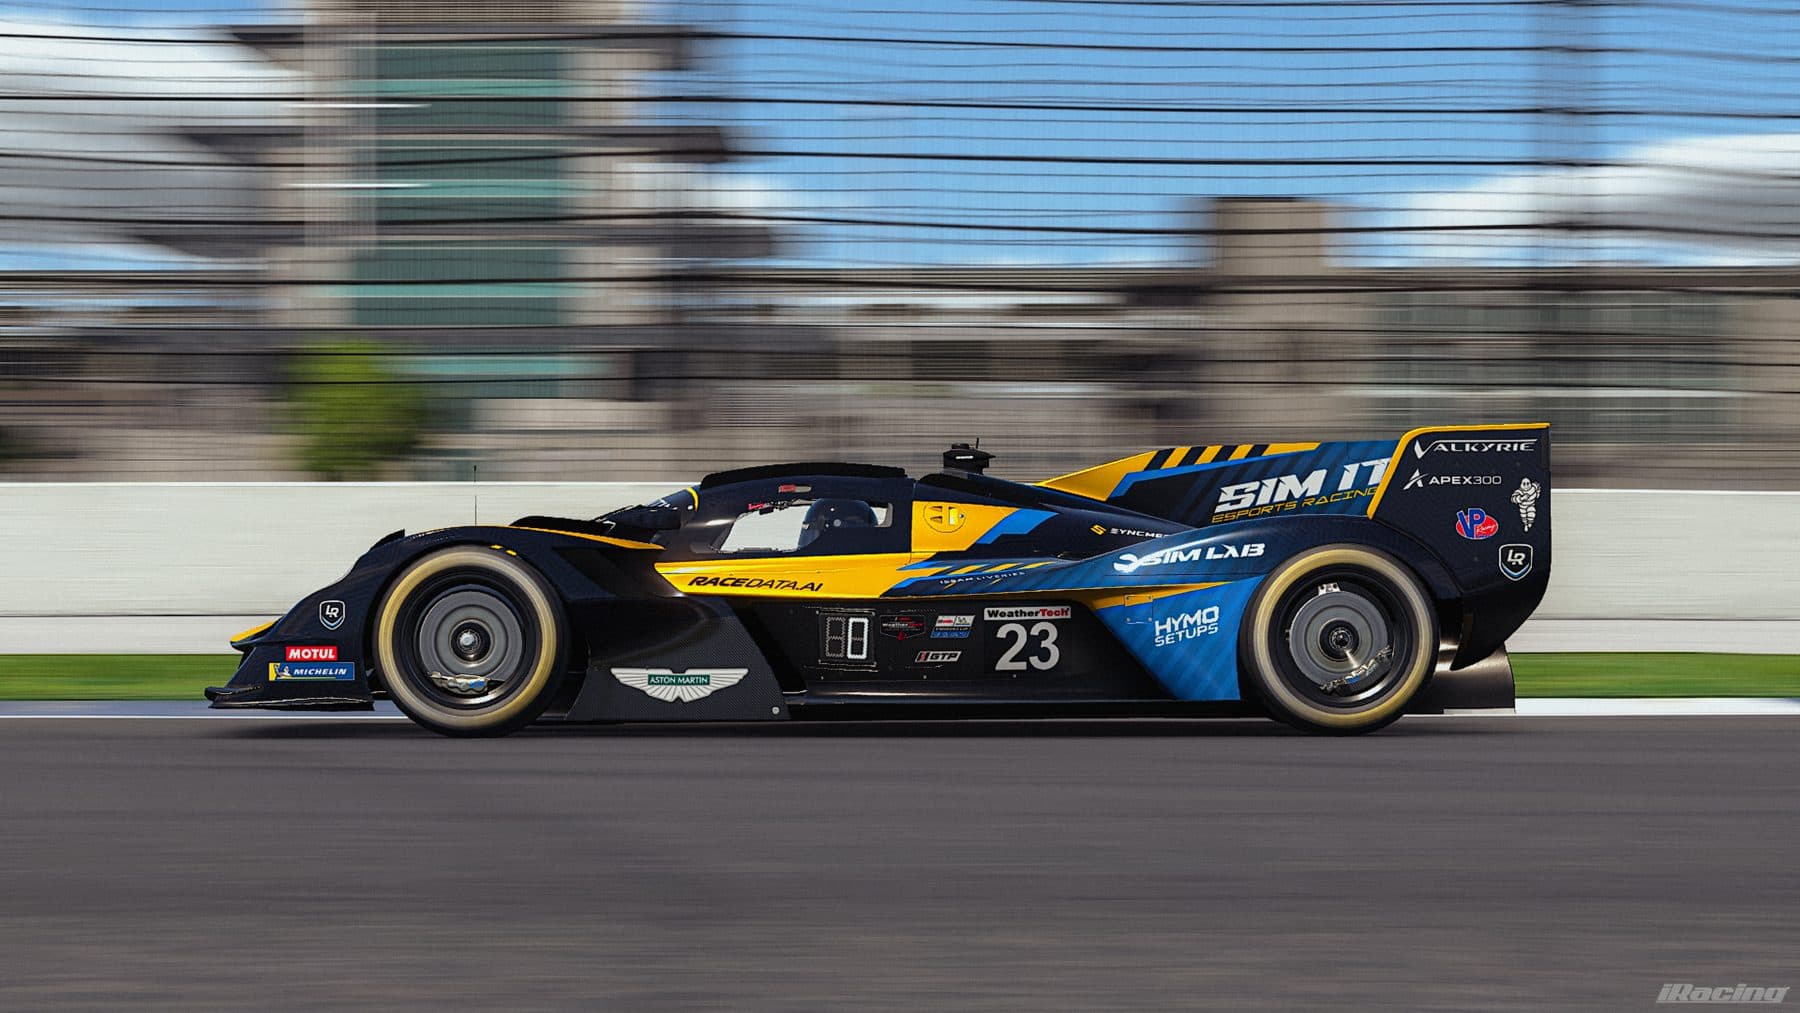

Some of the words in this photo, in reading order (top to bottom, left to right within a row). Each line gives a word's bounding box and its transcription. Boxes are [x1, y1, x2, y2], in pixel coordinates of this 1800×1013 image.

[1415, 438, 1537, 459] VALKYRIE
[1213, 469, 1327, 514] SIM
[1338, 457, 1391, 491] IT
[1428, 476, 1502, 485] APEX300
[1211, 501, 1297, 524] ESPORTS
[1205, 543, 1265, 560] LAB
[688, 576, 823, 592] RACEDATA.AI
[987, 607, 1070, 618] WeatherTech
[1154, 605, 1220, 637] HYMO
[1154, 623, 1219, 647] SETUPS
[288, 648, 336, 660] MOTUL
[995, 621, 1060, 671] 23
[928, 652, 959, 661] GTP
[293, 668, 347, 676] MICHELIN
[650, 676, 676, 684] ASTON
[677, 676, 708, 684] MARTIN
